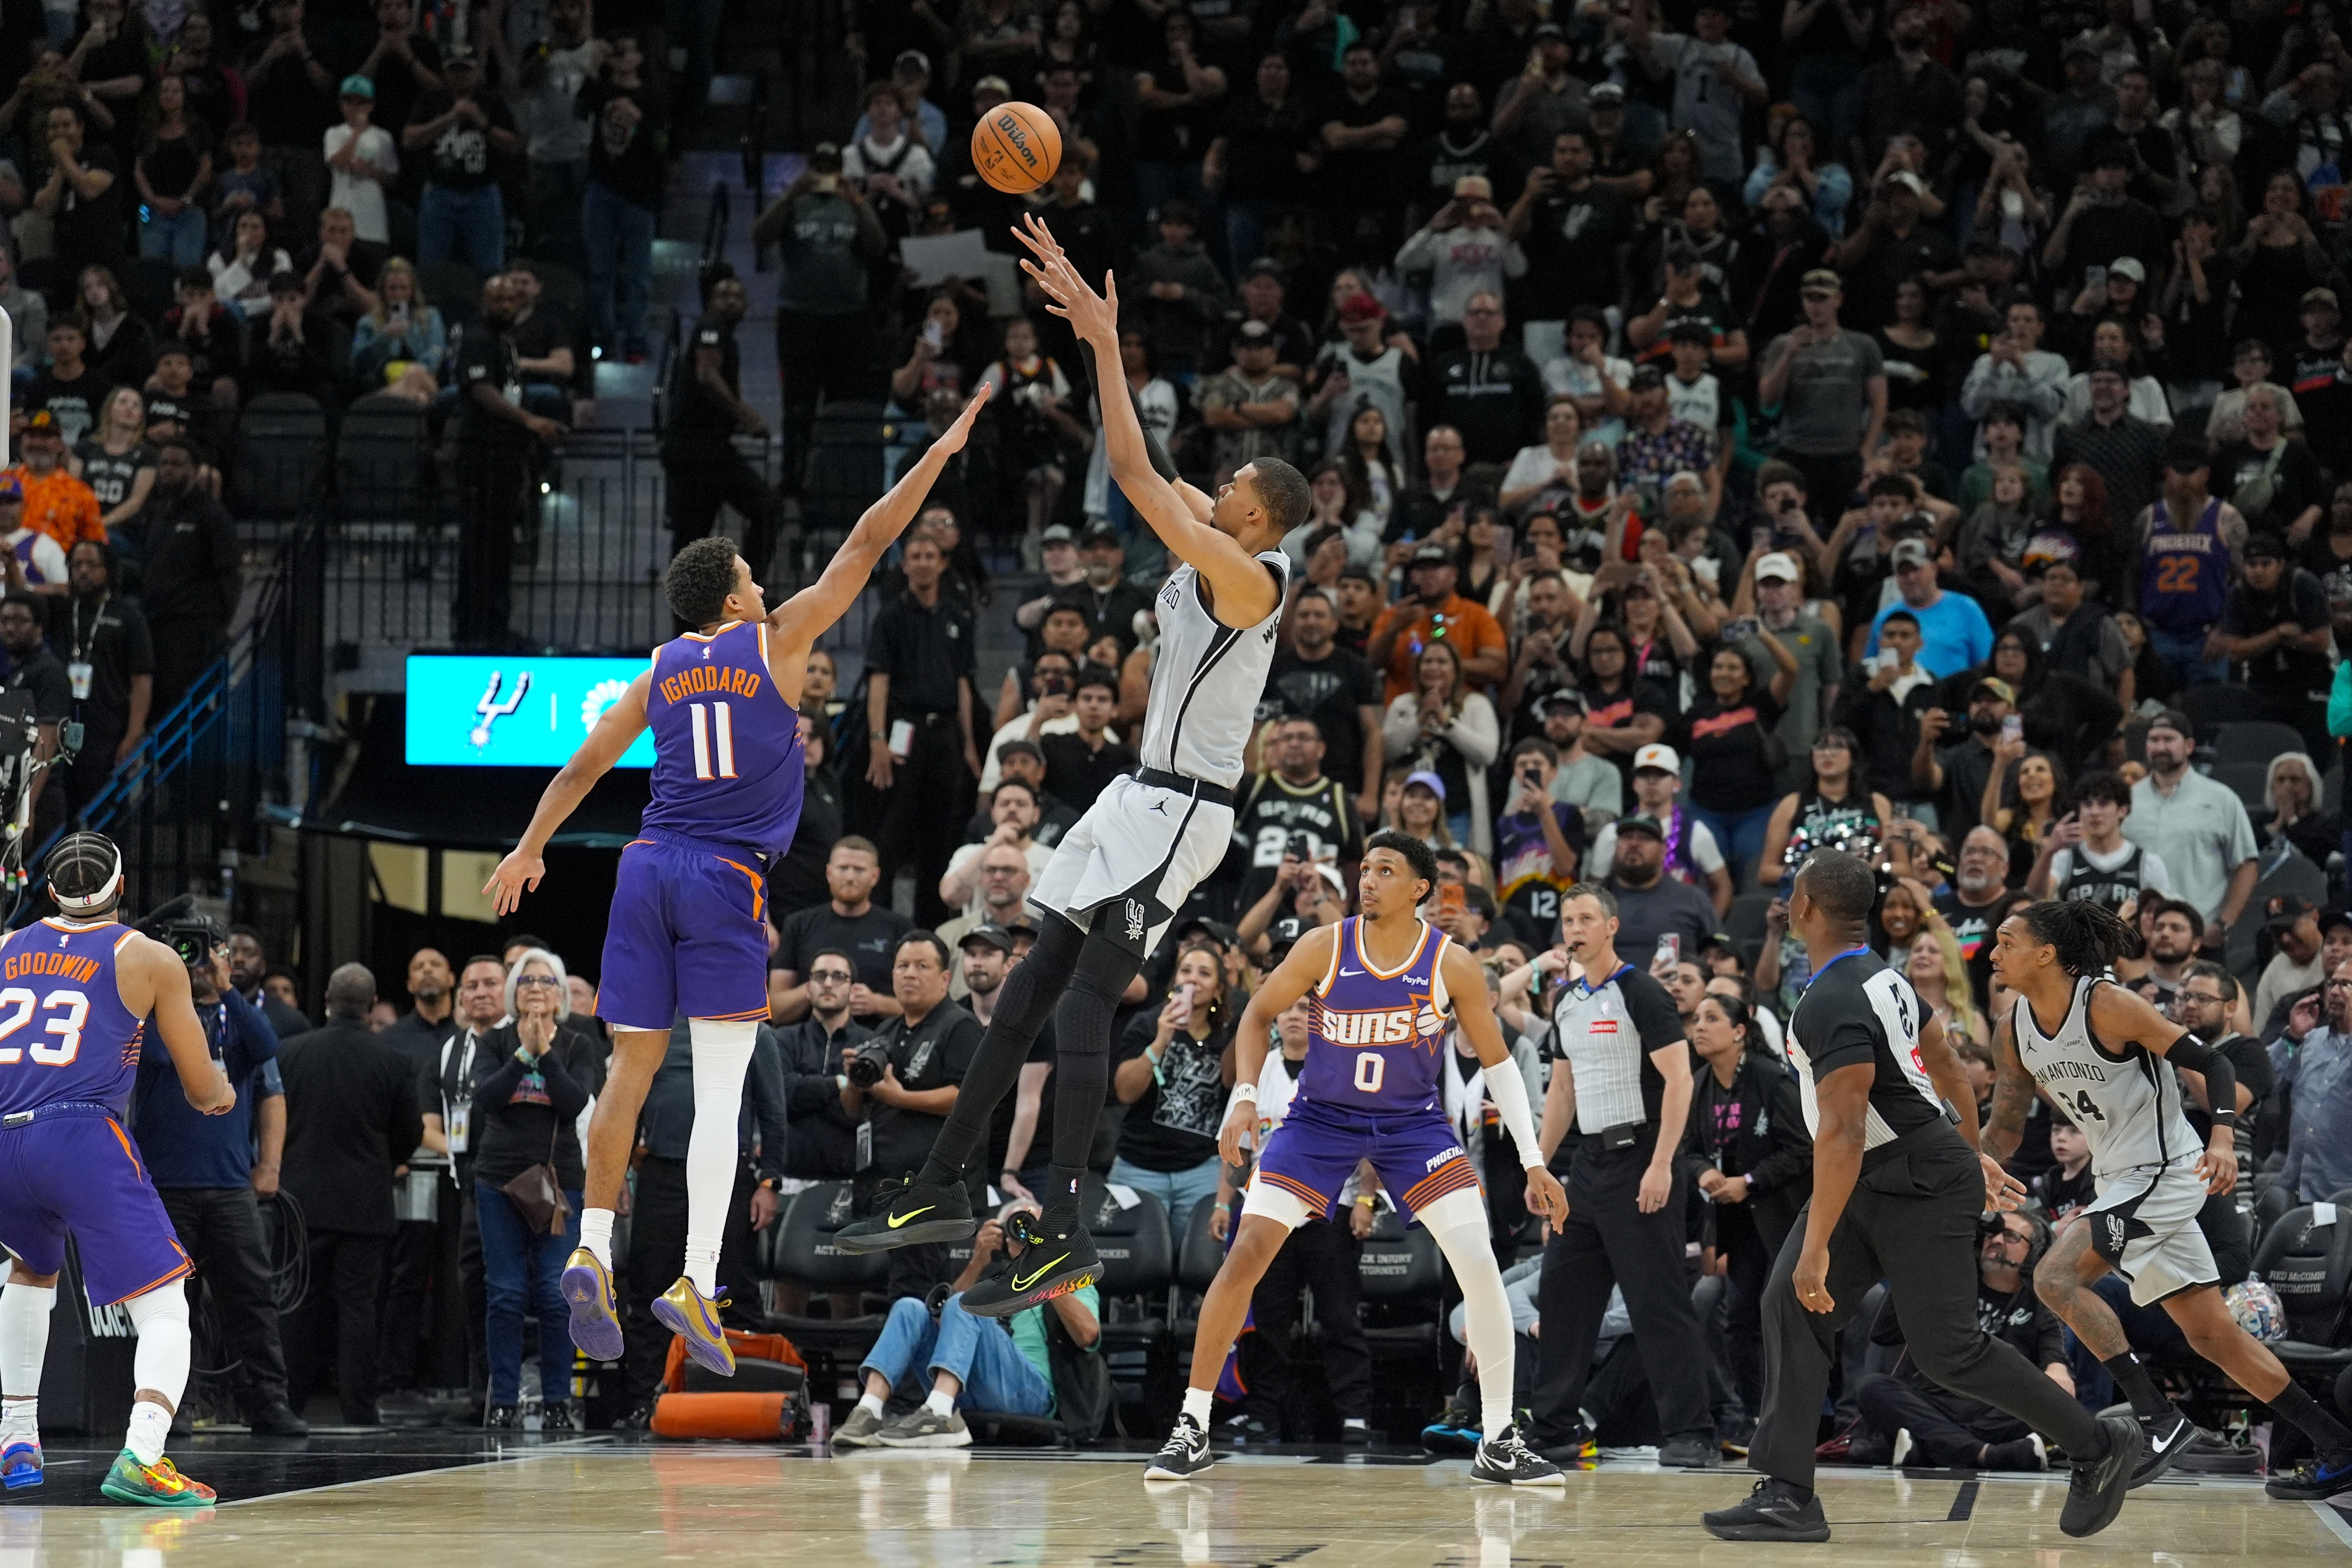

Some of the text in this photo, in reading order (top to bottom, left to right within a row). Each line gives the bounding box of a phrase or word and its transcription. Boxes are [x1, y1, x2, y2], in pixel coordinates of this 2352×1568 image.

[998, 114, 1037, 168] Wilson
[2157, 555, 2200, 593] 22
[659, 666, 761, 705] IGHODARO
[689, 701, 739, 780] 11
[1531, 890, 1557, 918] 12
[5, 952, 100, 983] GOODWIN
[1402, 975, 1429, 986] PayPal
[0, 988, 90, 1067] 23
[1590, 1023, 1617, 1031] Emirates
[1354, 1052, 1385, 1093] 0
[2047, 1061, 2106, 1082] ANTONIO
[1377, 1253, 1413, 1264] INJURY
